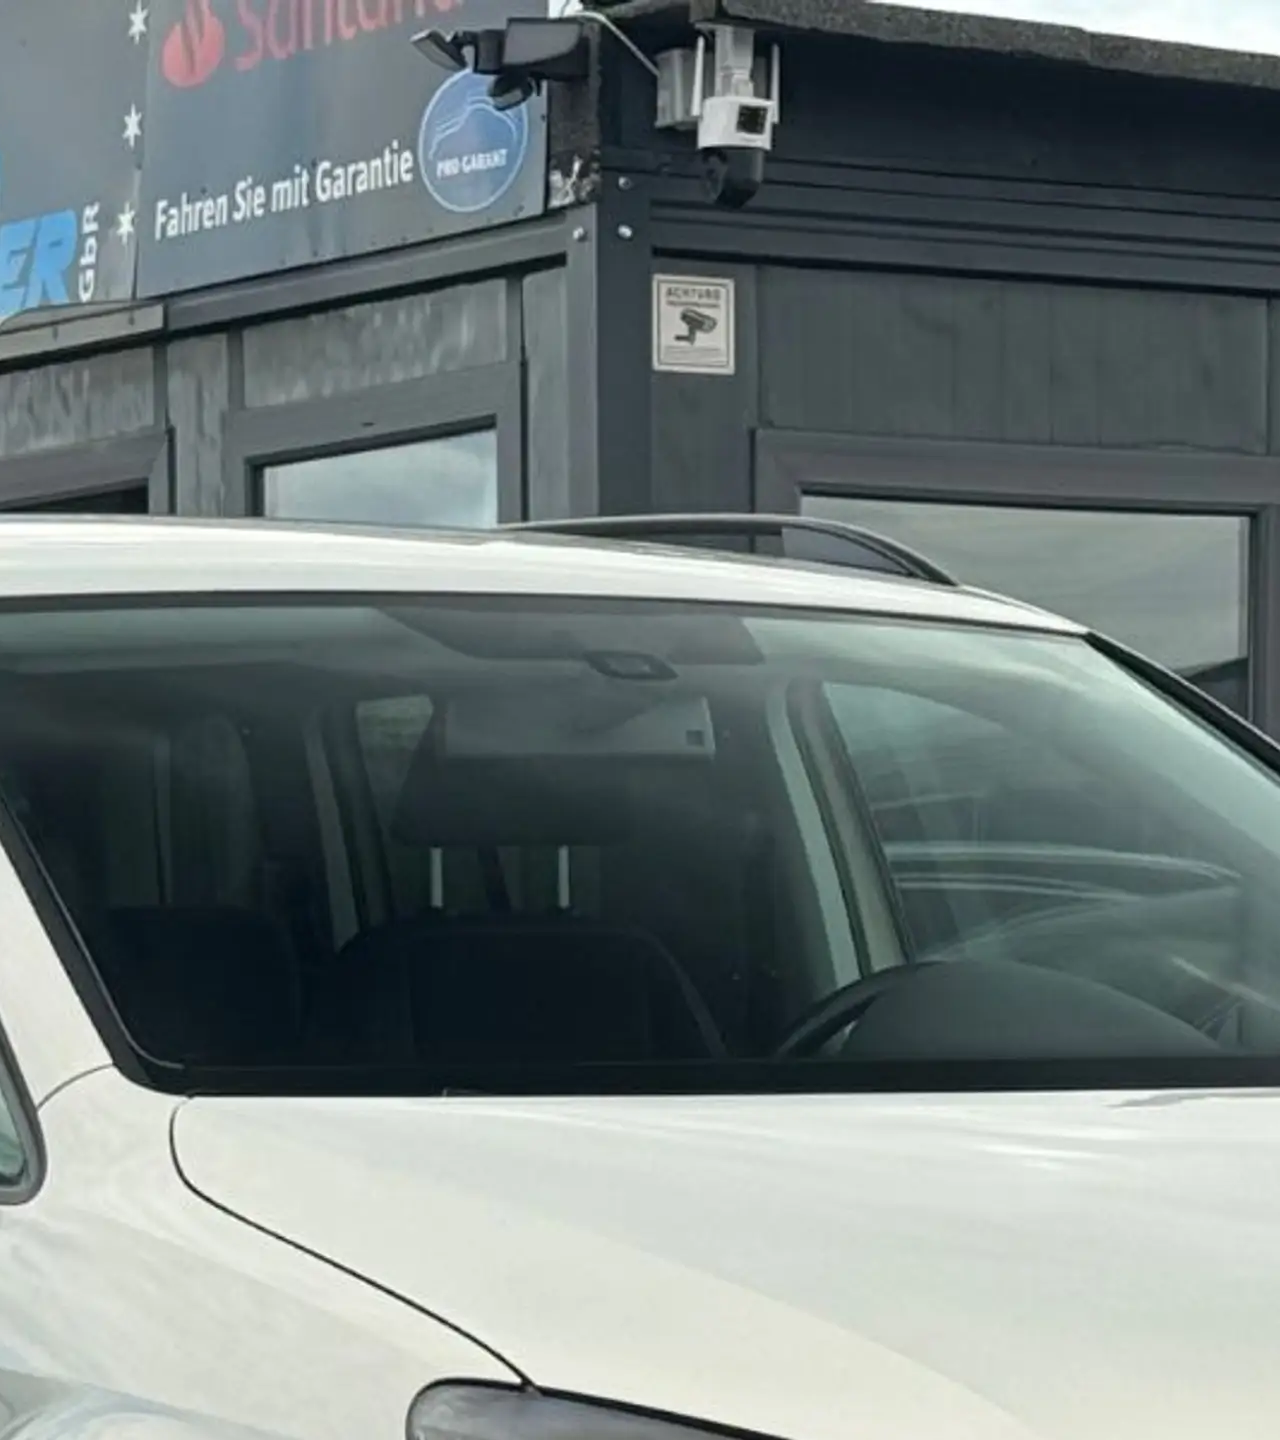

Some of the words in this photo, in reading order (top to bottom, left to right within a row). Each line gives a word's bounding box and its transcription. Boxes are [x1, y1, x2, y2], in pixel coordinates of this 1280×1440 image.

[154, 191, 228, 241] Fahren
[231, 175, 266, 223] Sie
[271, 164, 310, 213] mit
[315, 140, 414, 202] Garantie
[78, 201, 100, 303] GbR
